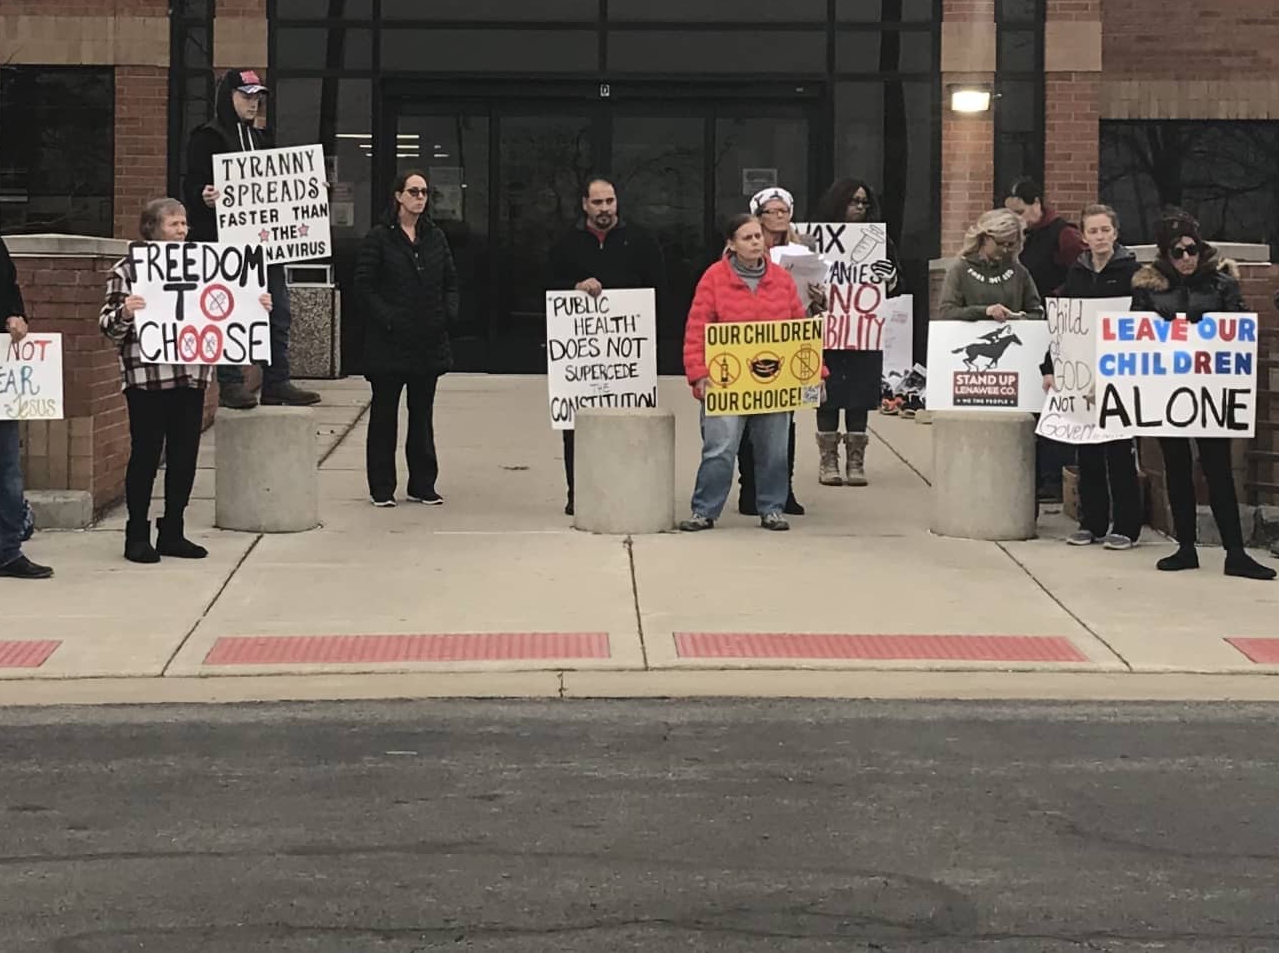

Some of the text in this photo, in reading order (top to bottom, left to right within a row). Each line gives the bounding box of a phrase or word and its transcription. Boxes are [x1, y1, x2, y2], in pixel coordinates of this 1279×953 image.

[222, 150, 314, 181] TYRANNY
[222, 177, 320, 208] SPREADS
[219, 209, 279, 229] FASTER
[293, 203, 328, 221] THAN
[272, 225, 297, 241] THE
[129, 241, 265, 287] FREEDOM
[266, 242, 326, 261] NAVIRUS
[163, 283, 234, 321] TO
[829, 283, 881, 314] NO
[1048, 298, 1089, 335] Child
[707, 320, 822, 345] OUR CHILDREN
[1103, 317, 1256, 342] LEAVE OUR
[7, 340, 52, 361] NOT
[139, 320, 269, 365] CHOOSE
[549, 337, 648, 361] DOES NOT
[565, 363, 639, 382] SUPERCEDE
[1099, 351, 1252, 376] CHILDREN
[590, 383, 610, 393] THE
[957, 375, 1015, 385] STAND UP
[707, 388, 801, 411] OUR CHOICE!
[1049, 396, 1075, 412] NOT
[1099, 383, 1251, 430] ALONE
